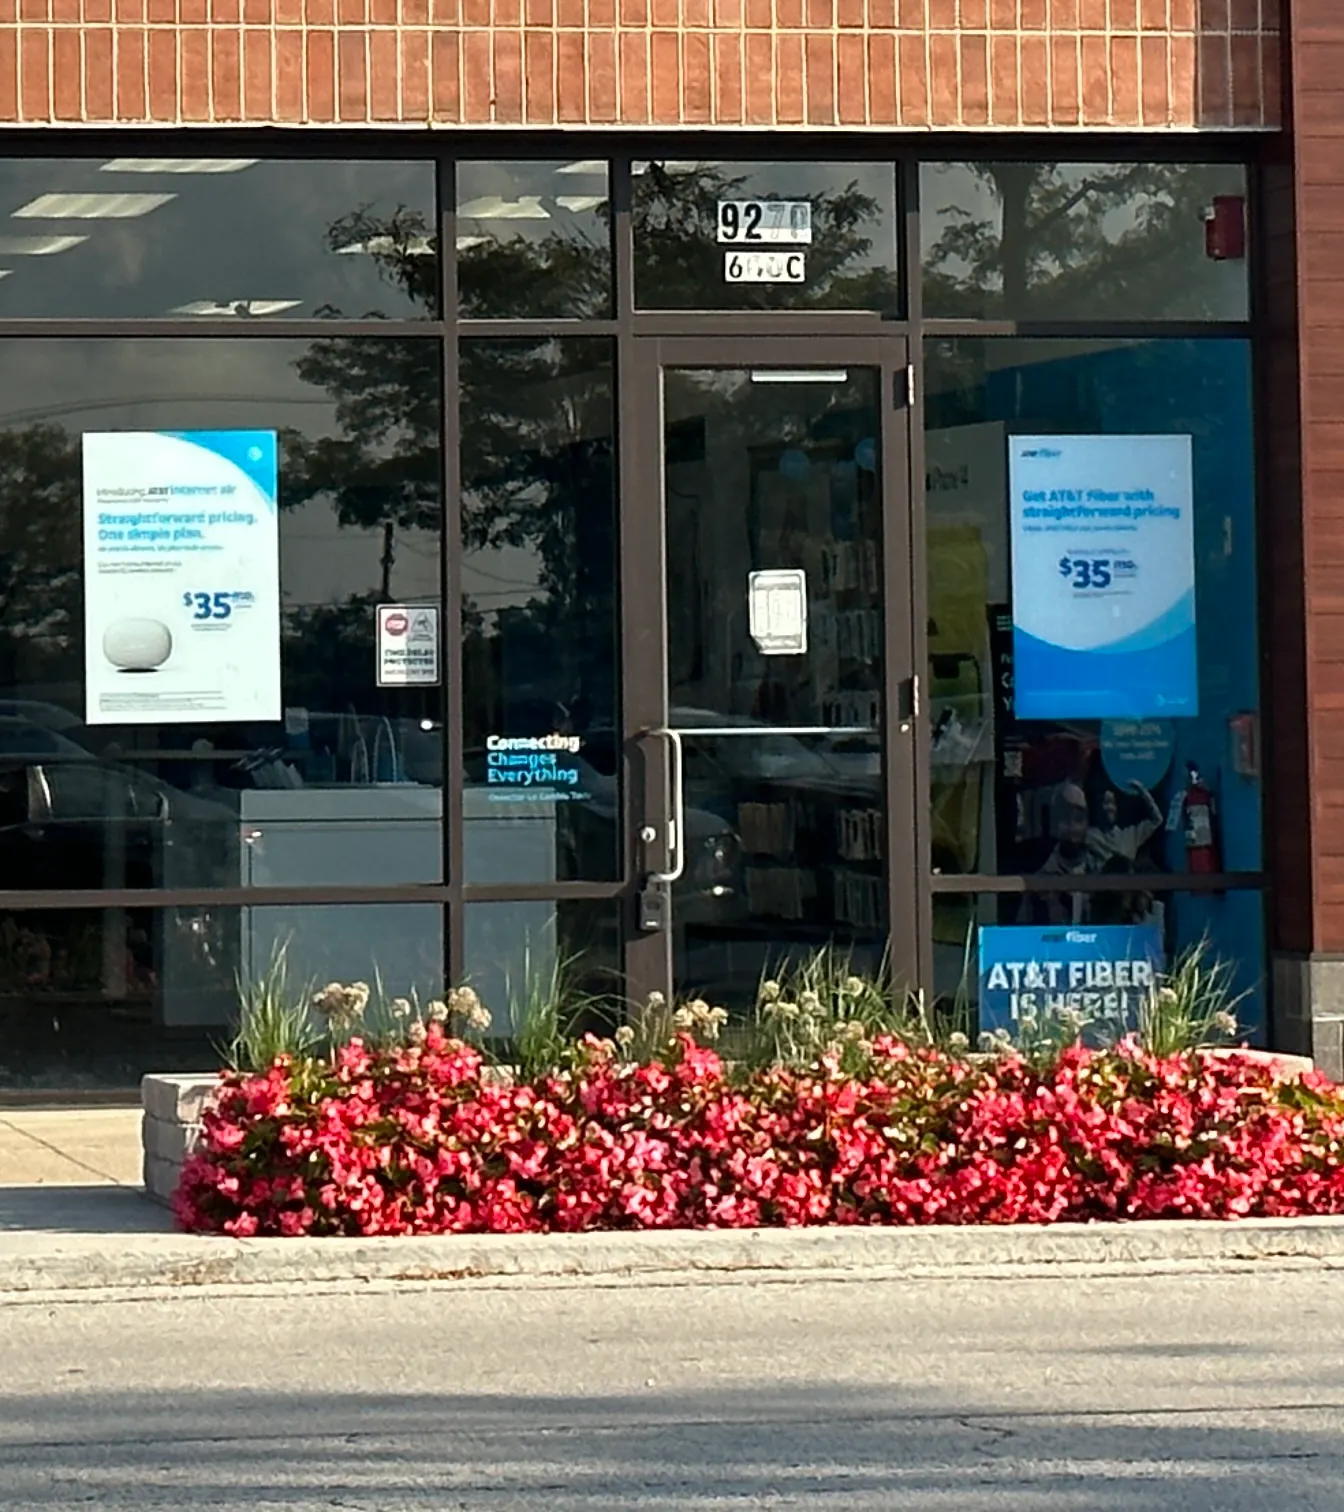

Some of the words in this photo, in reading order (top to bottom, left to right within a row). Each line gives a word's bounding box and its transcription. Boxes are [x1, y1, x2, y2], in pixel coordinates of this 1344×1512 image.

[98, 528, 124, 540] One
[128, 528, 171, 541] simple
[1059, 556, 1111, 588] $35
[183, 591, 232, 619] $35
[486, 733, 581, 753] Connecting
[487, 752, 557, 769] Changes
[487, 768, 579, 786] Everything
[987, 961, 1061, 989] AT&T
[1068, 959, 1151, 987] FIBER
